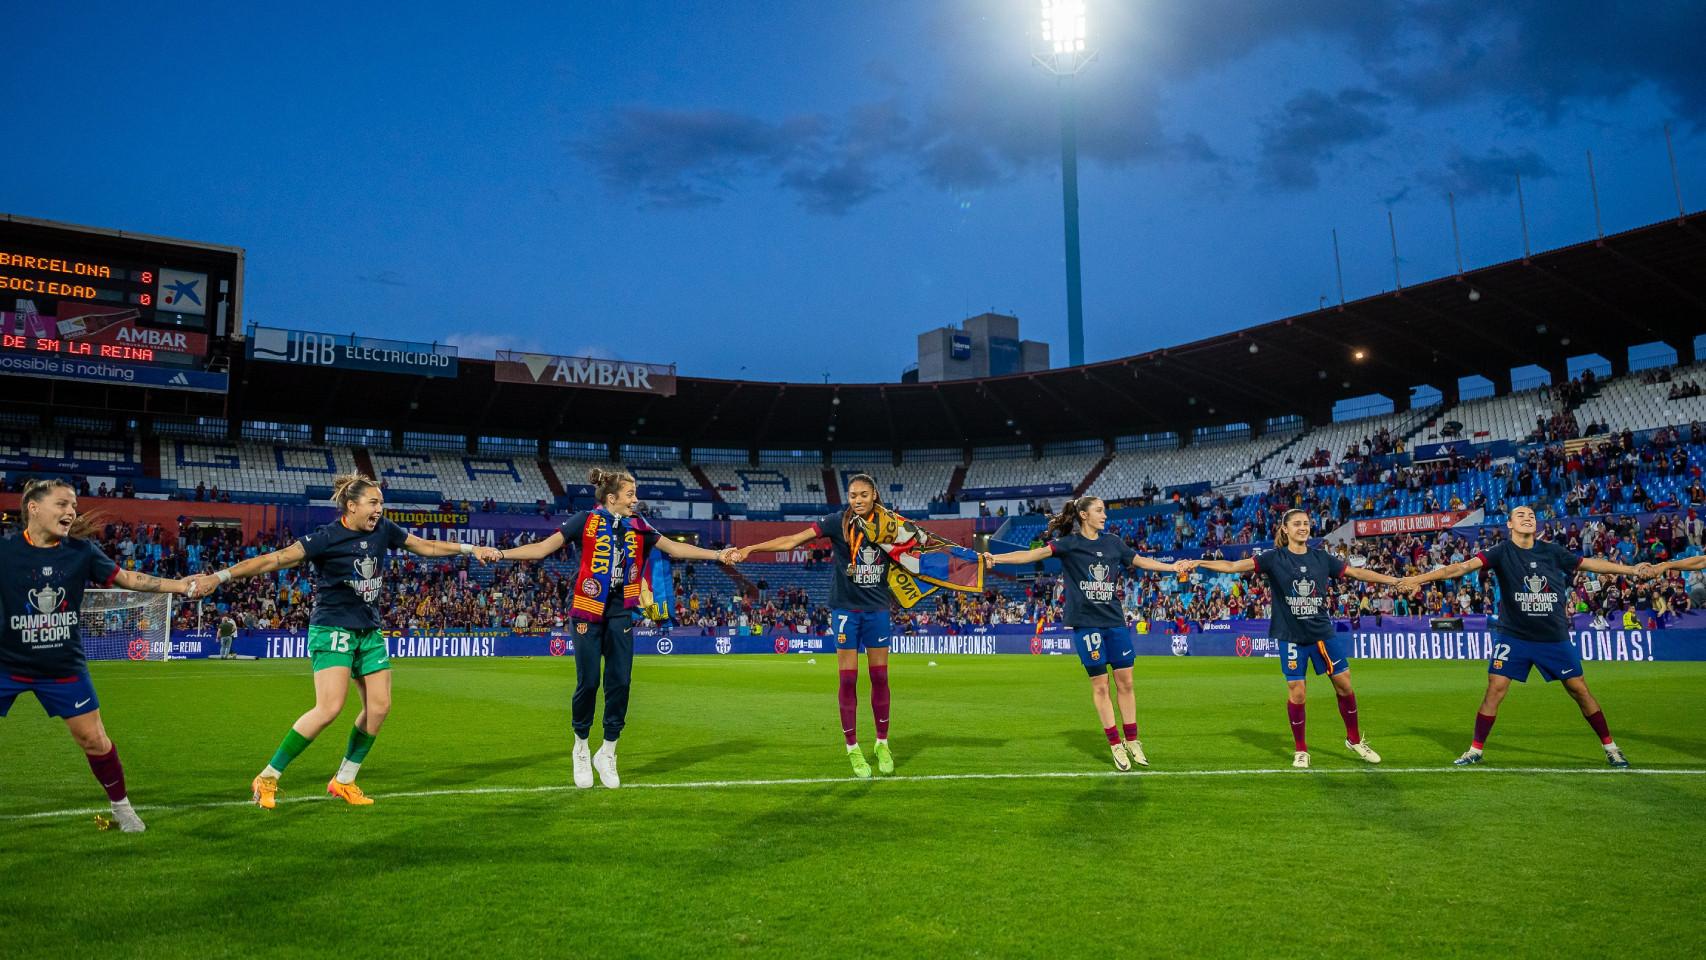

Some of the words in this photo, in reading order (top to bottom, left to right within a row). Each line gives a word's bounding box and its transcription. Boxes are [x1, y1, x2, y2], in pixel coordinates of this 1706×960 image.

[0, 253, 110, 278] BARCELONA
[141, 272, 152, 283] 8
[0, 276, 97, 299] SOCIEDAD
[139, 294, 151, 306] 0
[115, 326, 188, 349] AMBAR
[3, 334, 26, 349] DE
[37, 338, 60, 352] SM
[69, 341, 91, 355] LA
[100, 344, 153, 361] REINA
[290, 332, 335, 365] JAB
[346, 346, 449, 367] ELECTRICIDAD
[0, 357, 58, 372] ossible
[62, 361, 74, 373] is
[77, 364, 134, 381] nothing
[552, 359, 653, 389] AMBAR
[384, 507, 468, 525] lmogavers
[1381, 519, 1398, 532] COPA
[1399, 518, 1407, 531] DE
[1407, 517, 1416, 531] LA
[1416, 515, 1435, 530] REINA
[590, 534, 611, 574] SOLES
[1080, 580, 1115, 592] CAMPIONE
[1086, 590, 1096, 600] DE
[1096, 591, 1113, 601] COPA
[1515, 592, 1558, 603] CAMPIONES
[1291, 605, 1301, 616] DE
[1521, 602, 1532, 612] DE
[1533, 602, 1553, 612] COPA
[10, 611, 78, 630] CAMPIONES
[838, 614, 848, 633] 7
[22, 629, 39, 643] DE
[40, 625, 71, 642] COPA
[330, 630, 351, 652] 13
[1082, 632, 1102, 652] 19
[153, 641, 173, 653] COA
[179, 641, 202, 653] REINA
[1255, 639, 1270, 651] COPA
[1287, 642, 1298, 660] 5
[1493, 643, 1511, 661] 12
